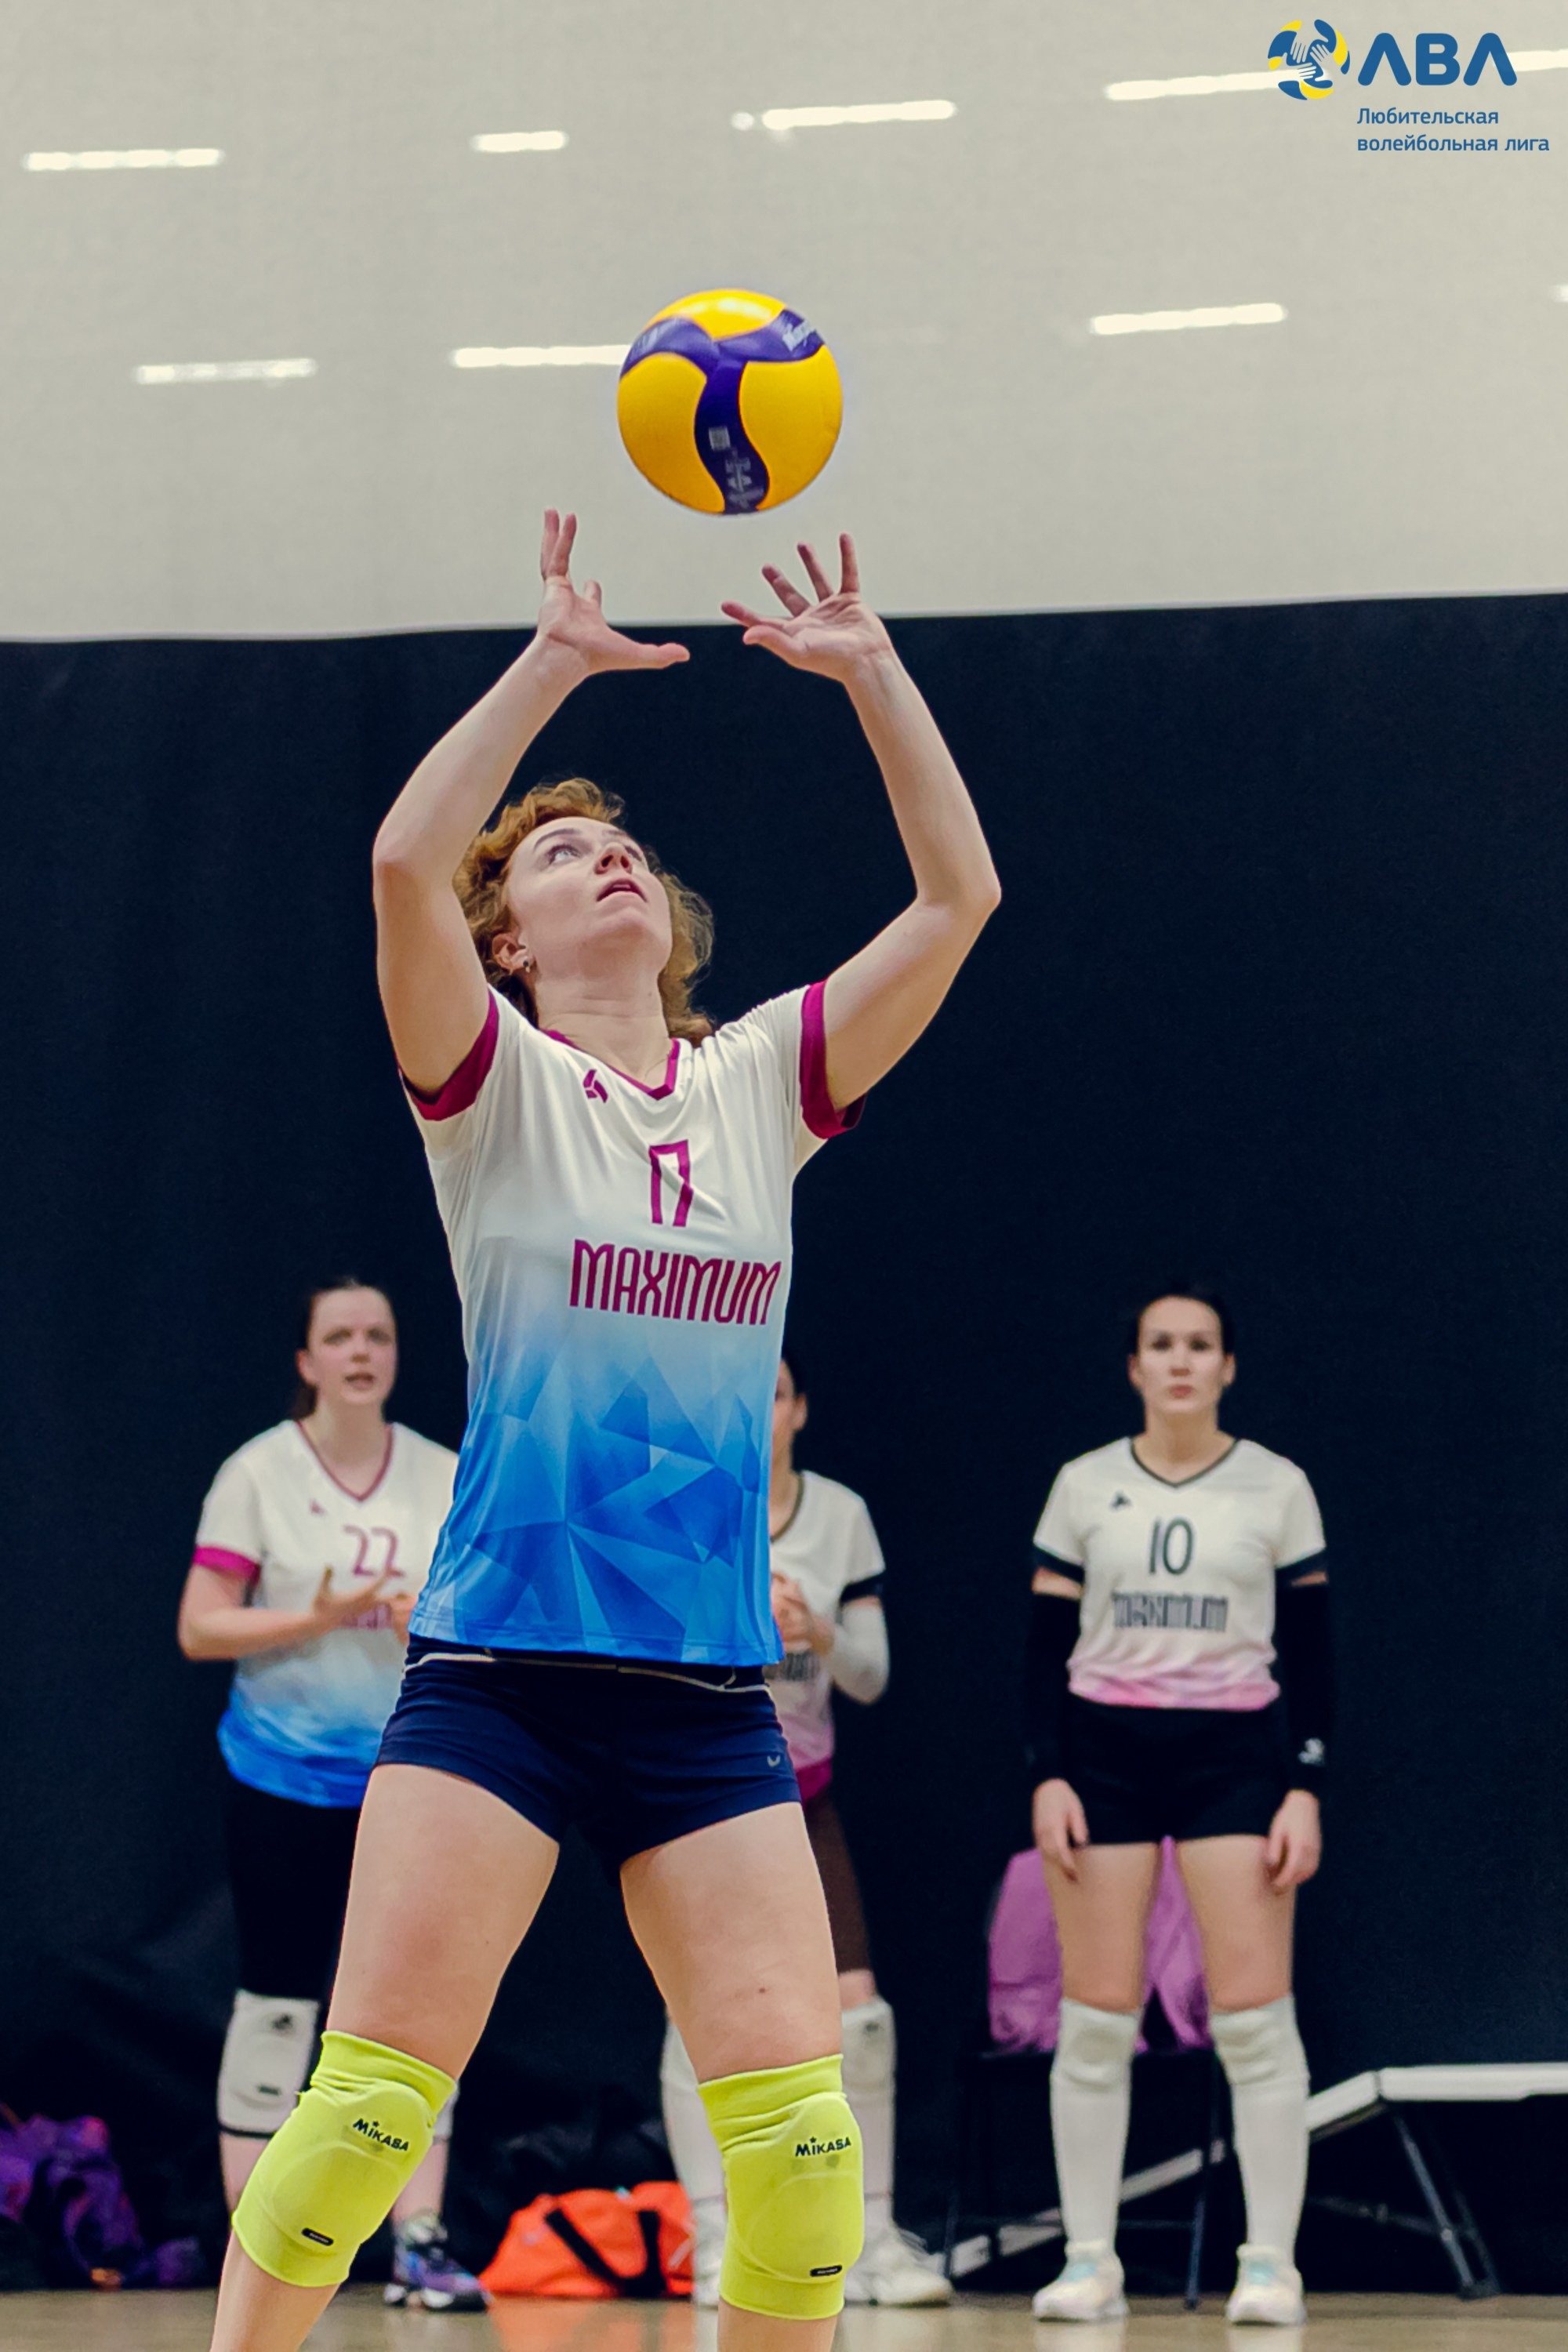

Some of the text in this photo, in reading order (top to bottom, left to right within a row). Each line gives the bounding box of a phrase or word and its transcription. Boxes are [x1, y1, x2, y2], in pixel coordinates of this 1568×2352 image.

[648, 1139, 695, 1228] 17
[569, 1238, 782, 1326] MAXIMUM
[343, 1524, 405, 1577] 22
[1149, 1516, 1194, 1576] 10
[795, 2136, 852, 2158] MIKASA
